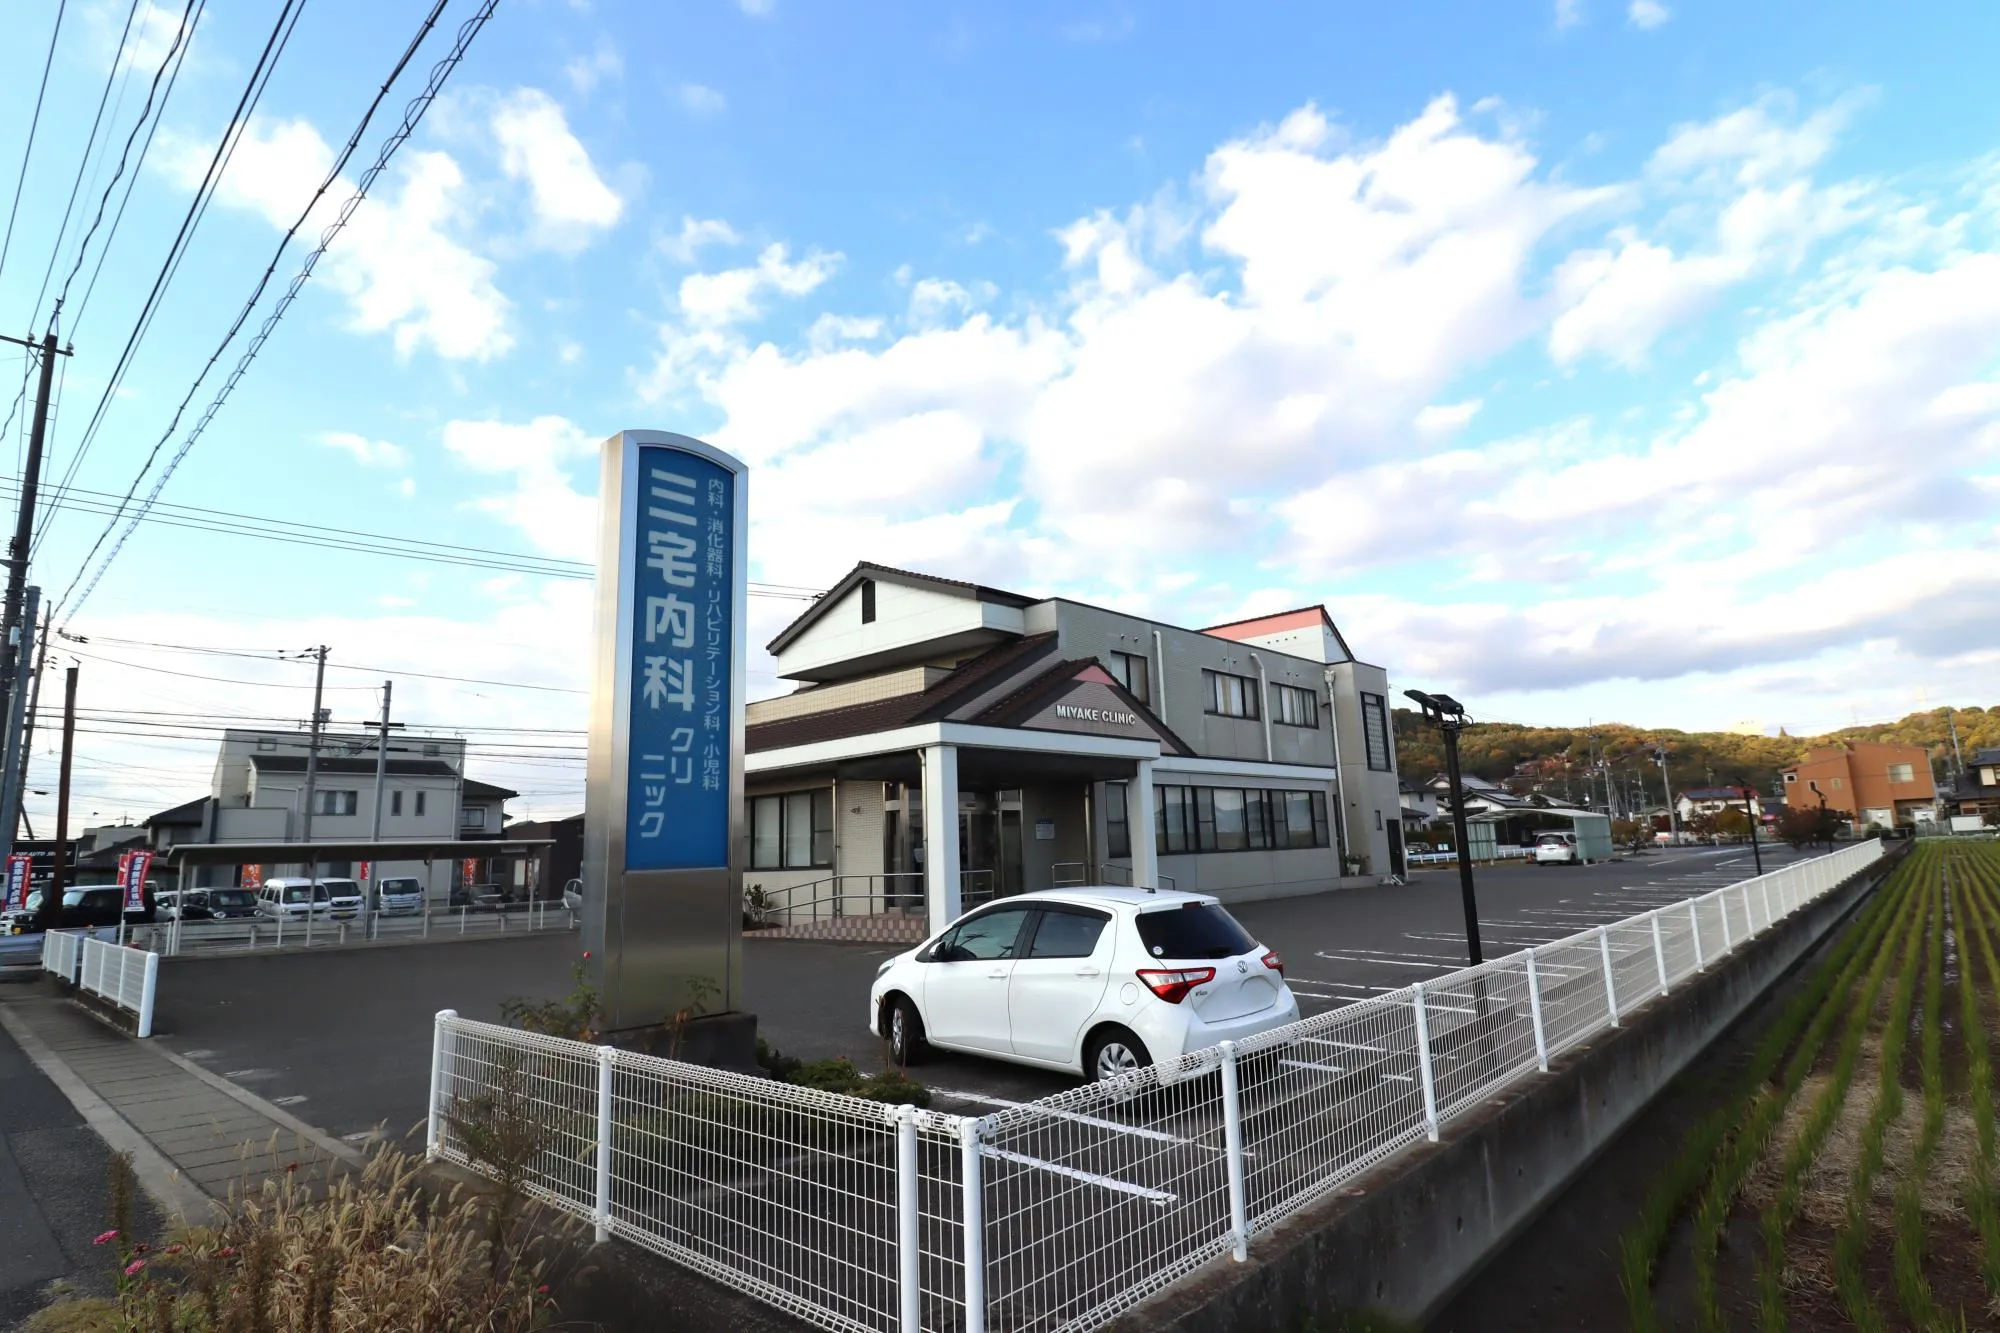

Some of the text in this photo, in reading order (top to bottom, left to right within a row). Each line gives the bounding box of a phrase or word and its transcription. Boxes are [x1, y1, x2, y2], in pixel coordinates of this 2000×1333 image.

[643, 468, 697, 713] 三宅内科
[1056, 704, 1136, 725] MIYAKE CLINIC
